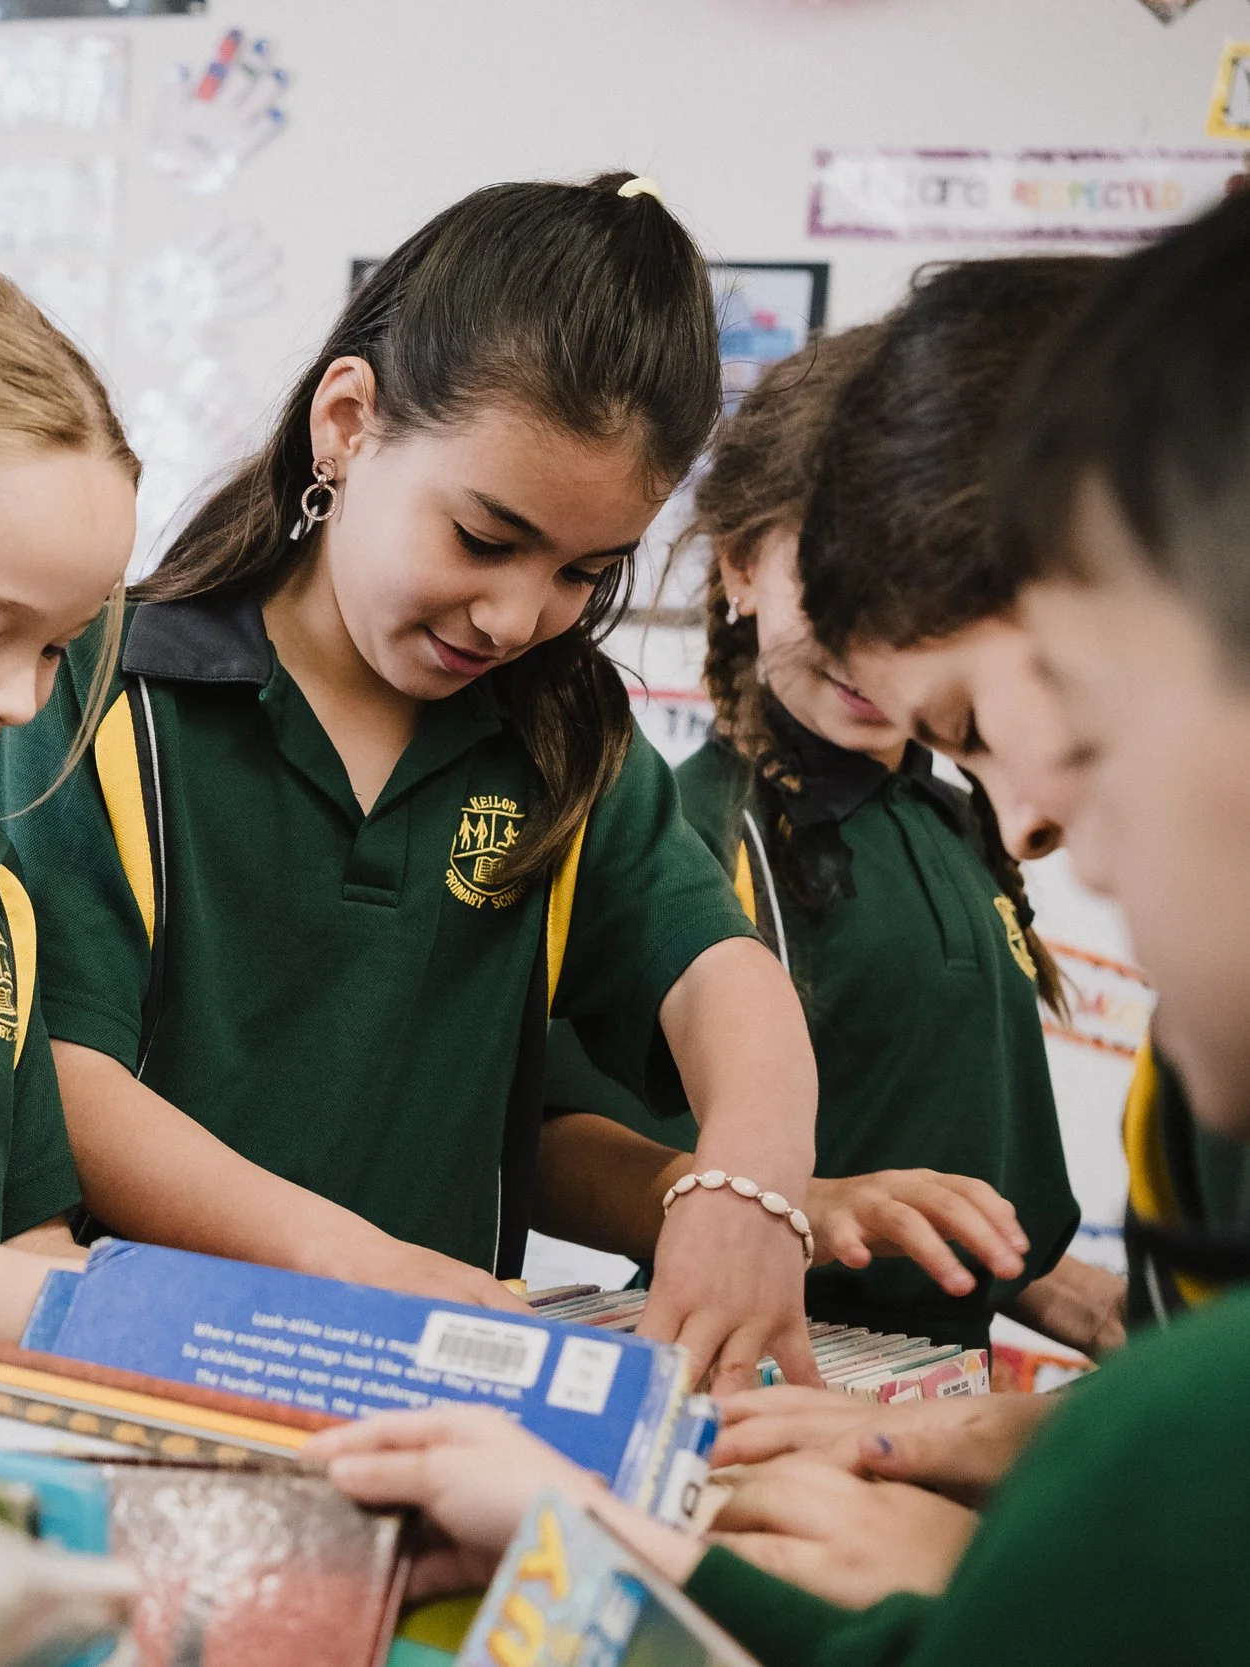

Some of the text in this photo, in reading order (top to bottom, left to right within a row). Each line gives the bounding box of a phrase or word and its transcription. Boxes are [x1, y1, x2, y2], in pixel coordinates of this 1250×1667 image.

[469, 795, 517, 814] KEILOR
[445, 868, 528, 909] PRIMARY SCHOO
[235, 1332, 297, 1358] everyday
[298, 1343, 342, 1367] things
